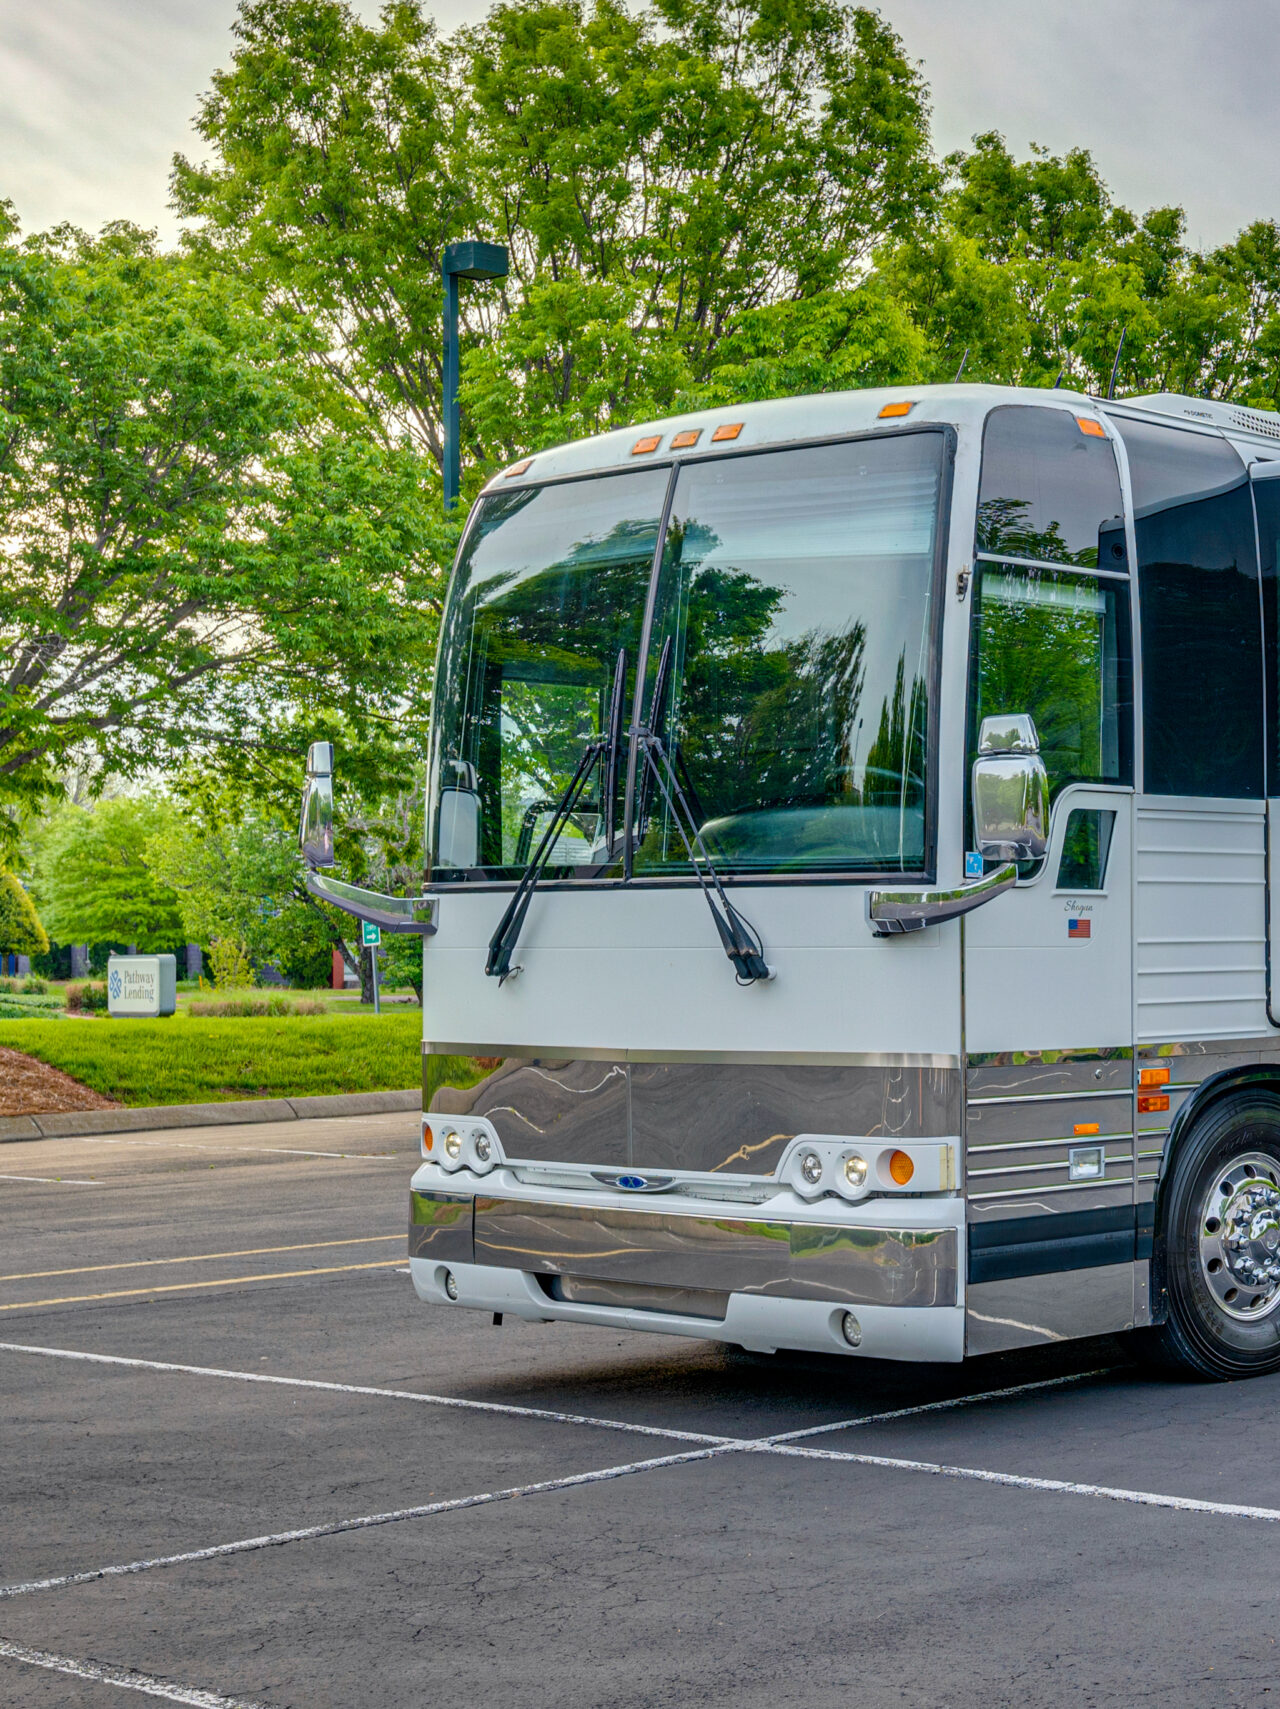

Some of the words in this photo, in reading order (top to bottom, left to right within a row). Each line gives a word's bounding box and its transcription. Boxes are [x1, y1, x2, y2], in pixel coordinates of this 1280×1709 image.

[1064, 899, 1094, 917] Shogun
[124, 970, 154, 987] Pathway
[124, 986, 154, 1003] Lending
